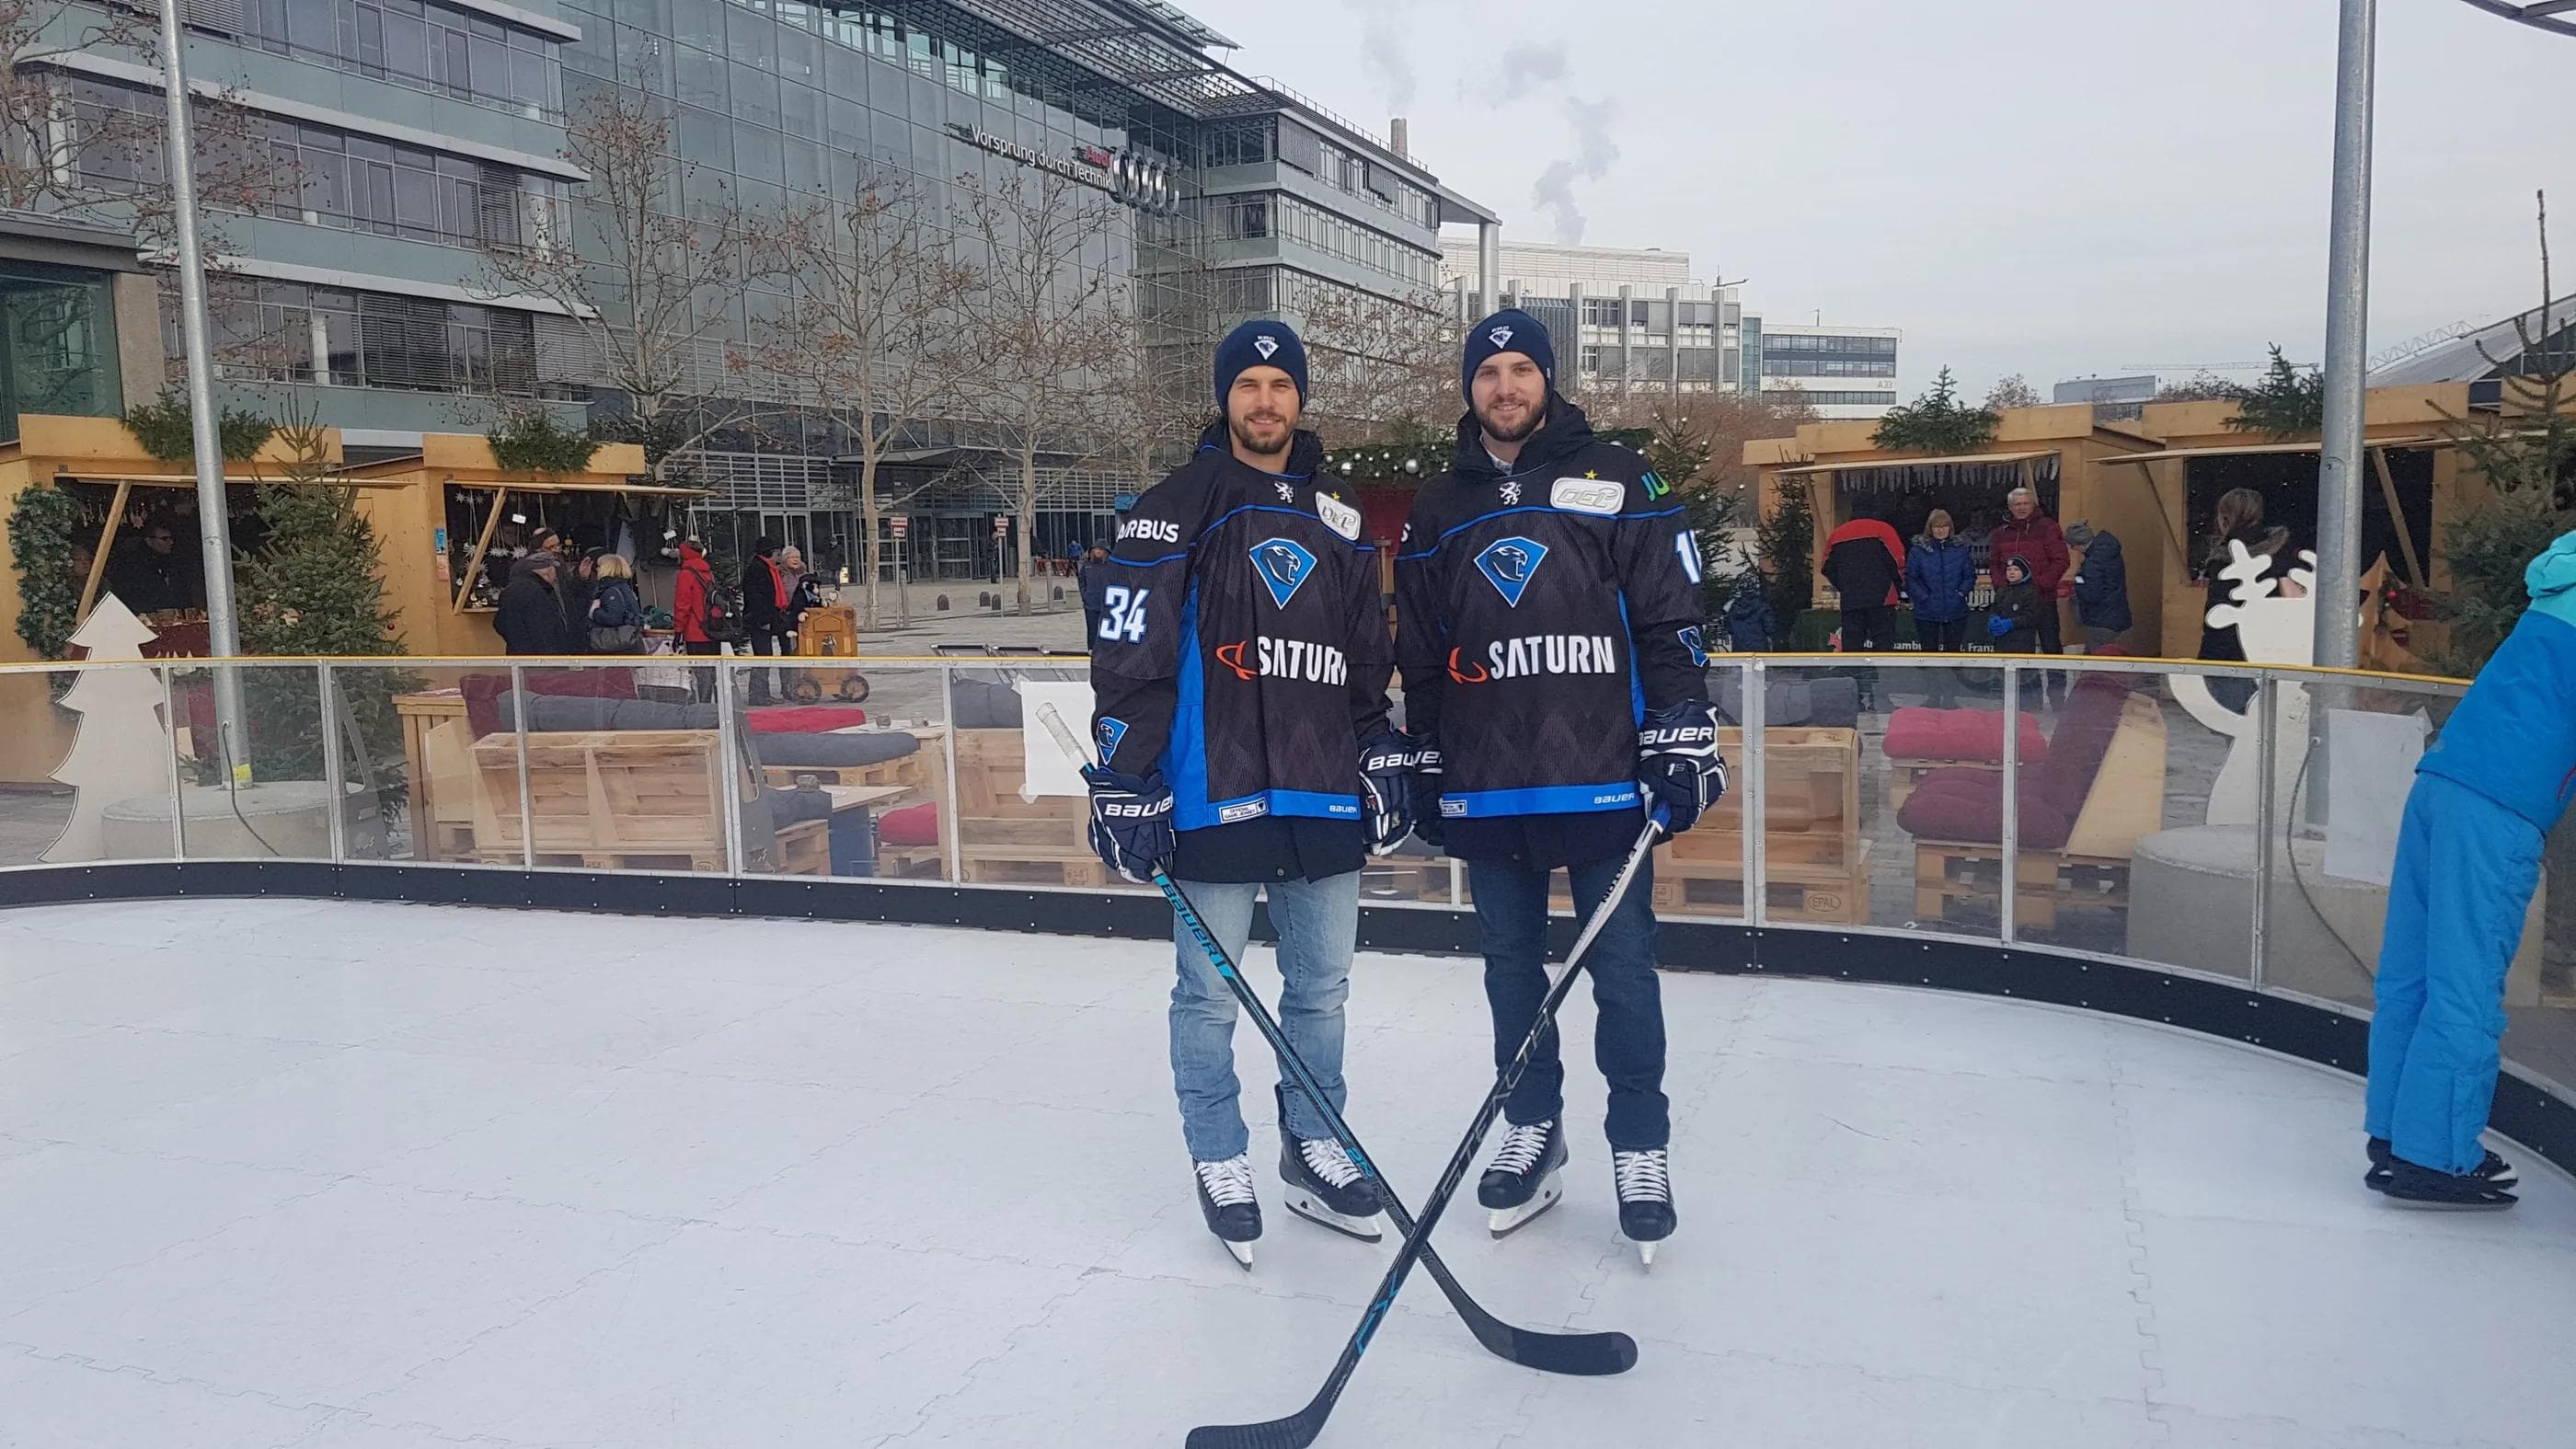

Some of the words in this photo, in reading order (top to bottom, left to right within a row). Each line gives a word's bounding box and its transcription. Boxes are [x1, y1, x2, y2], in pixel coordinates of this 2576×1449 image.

[971, 123, 1036, 167] Vorsprung
[1038, 151, 1070, 174] durch
[1072, 161, 1111, 189] Technik
[1087, 145, 1111, 167] Audi
[1877, 380, 1893, 388] A33
[1099, 585, 1150, 642] 34
[1489, 635, 1616, 680] SATURN
[1593, 793, 1635, 804] BAUER
[1601, 847, 1637, 903] EASTON
